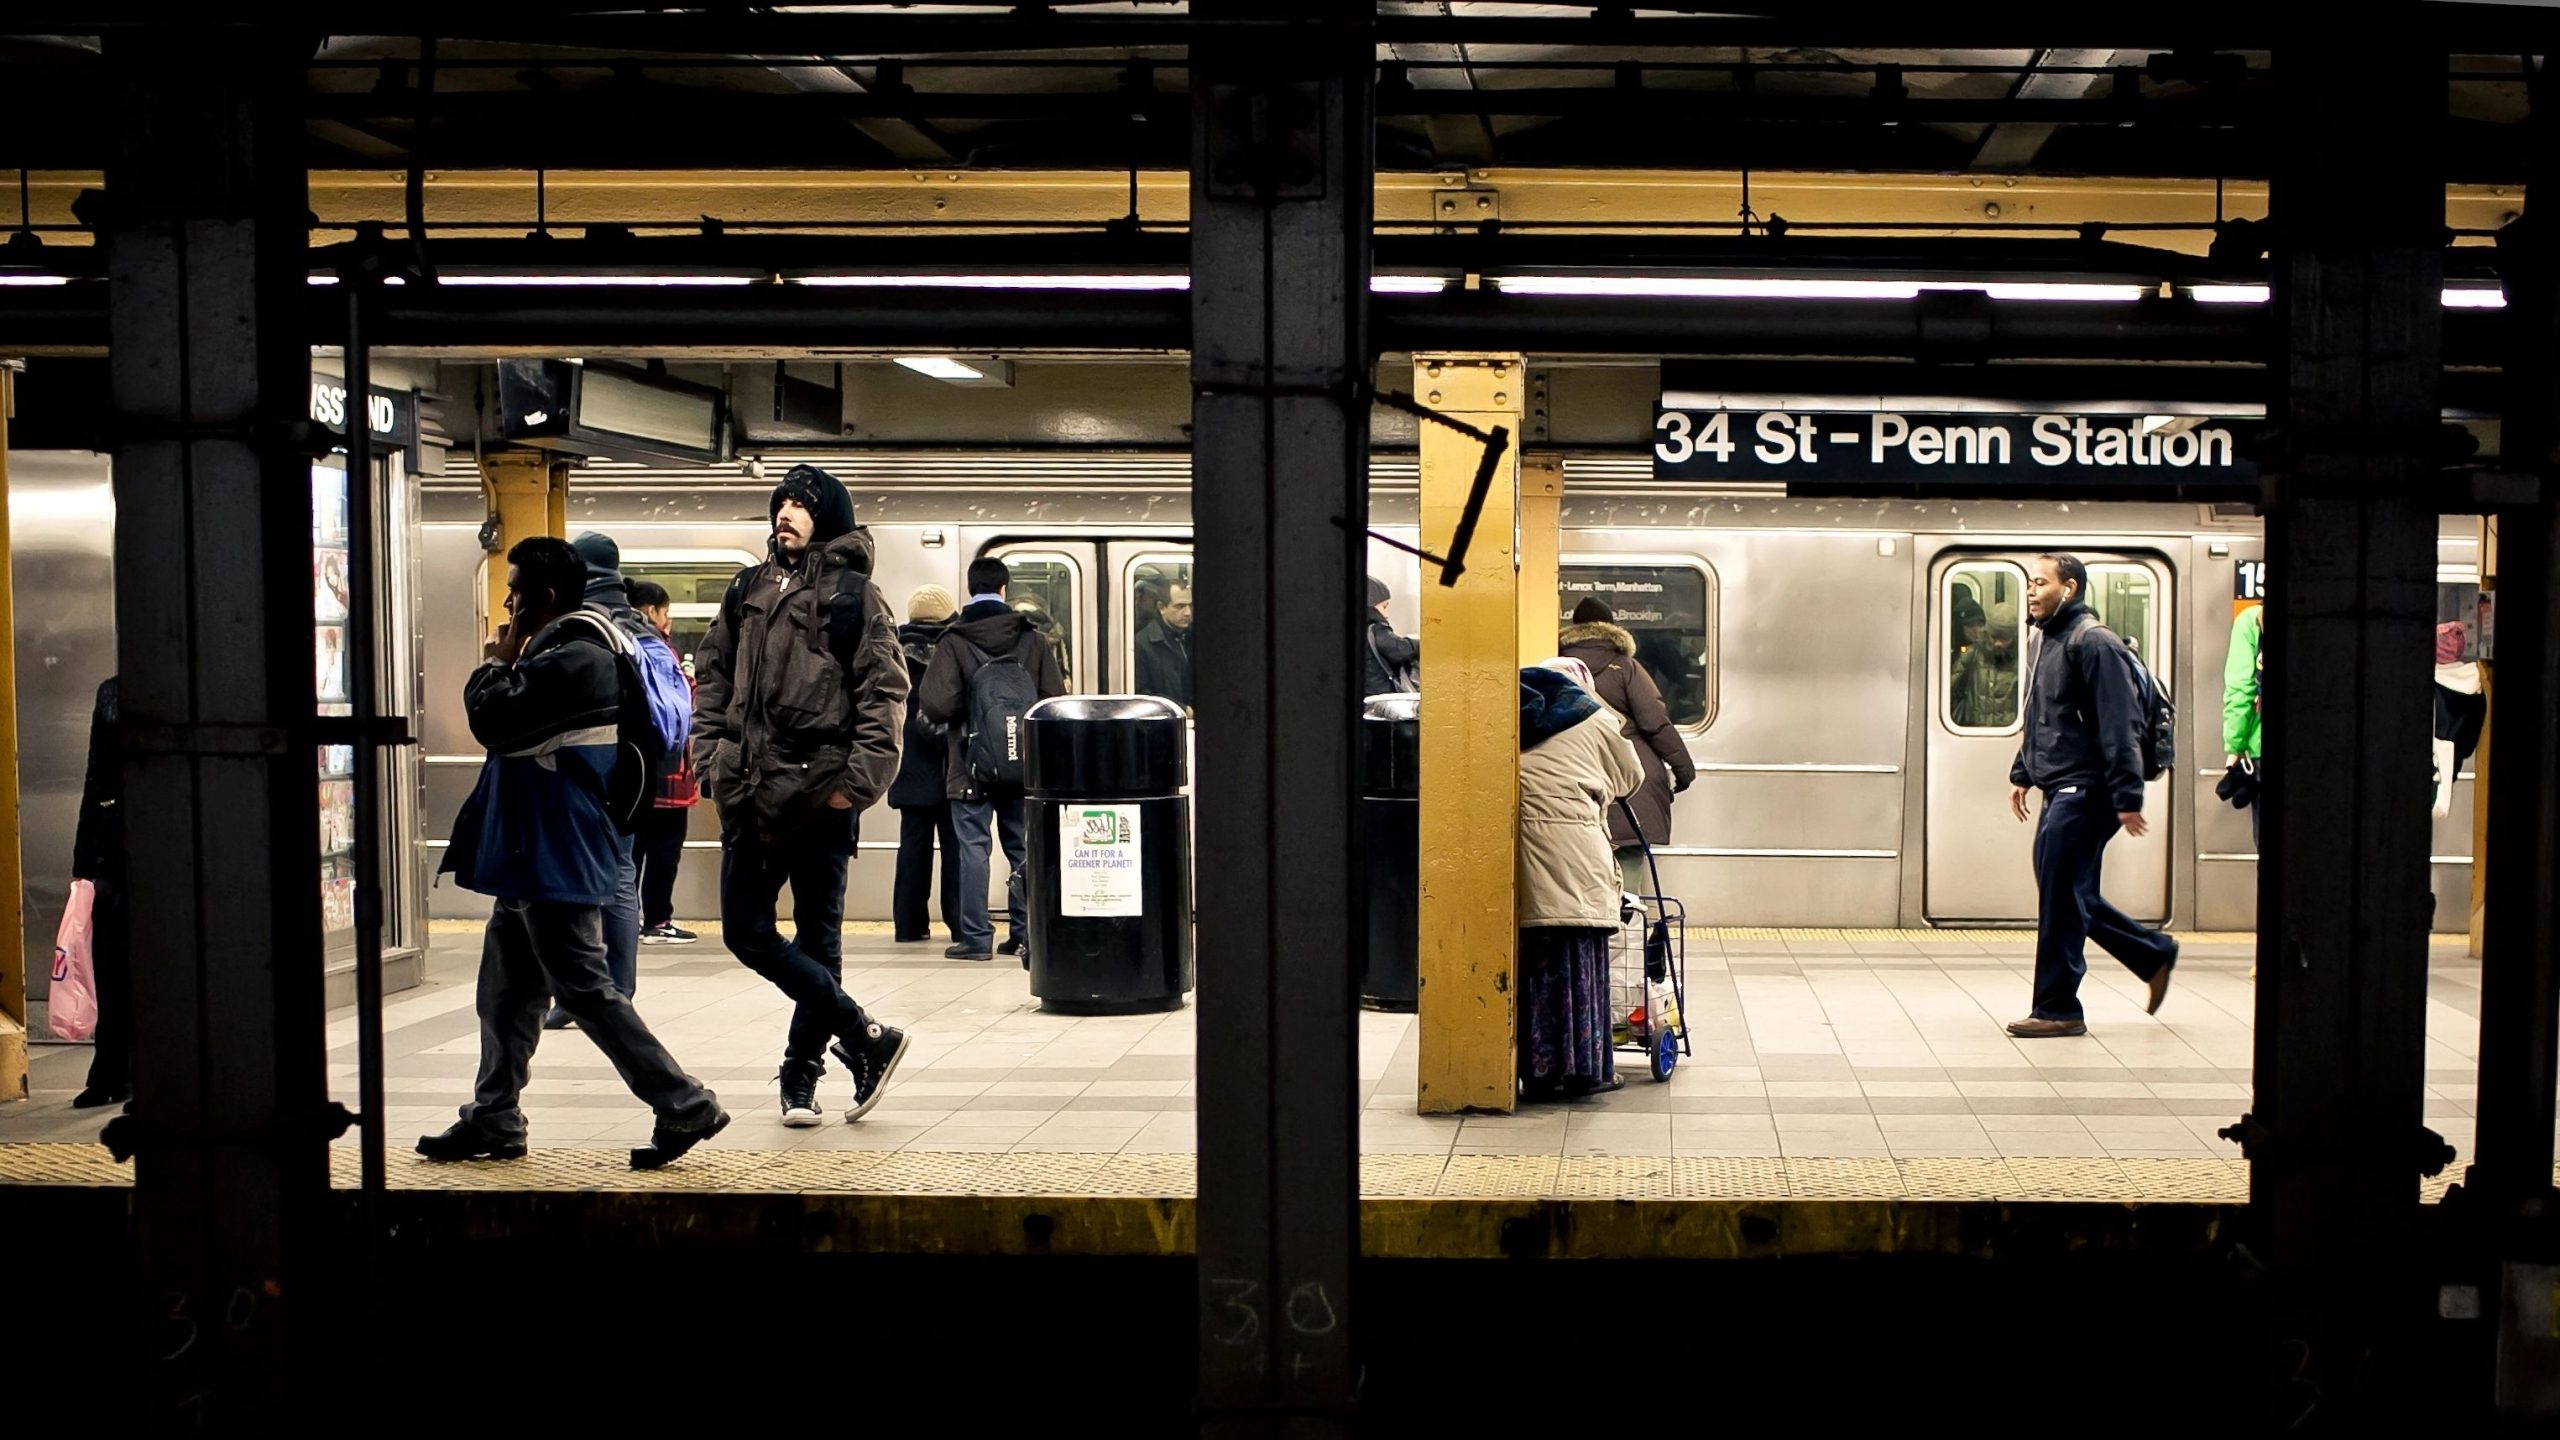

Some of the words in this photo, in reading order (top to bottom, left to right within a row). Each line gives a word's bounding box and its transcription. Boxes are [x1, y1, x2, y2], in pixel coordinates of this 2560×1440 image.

[1655, 411, 1736, 463] 34
[1754, 411, 1818, 464] St
[1872, 412, 2011, 464] Penn
[2030, 412, 2233, 467] Station
[1006, 716, 1018, 761] Marmot
[1068, 859, 1101, 868] GREENER
[1103, 859, 1133, 868] PLANET!
[1074, 849, 1090, 858] CAN
[1091, 849, 1099, 858] IT
[1100, 849, 1116, 858] FOR
[1118, 849, 1124, 858] A
